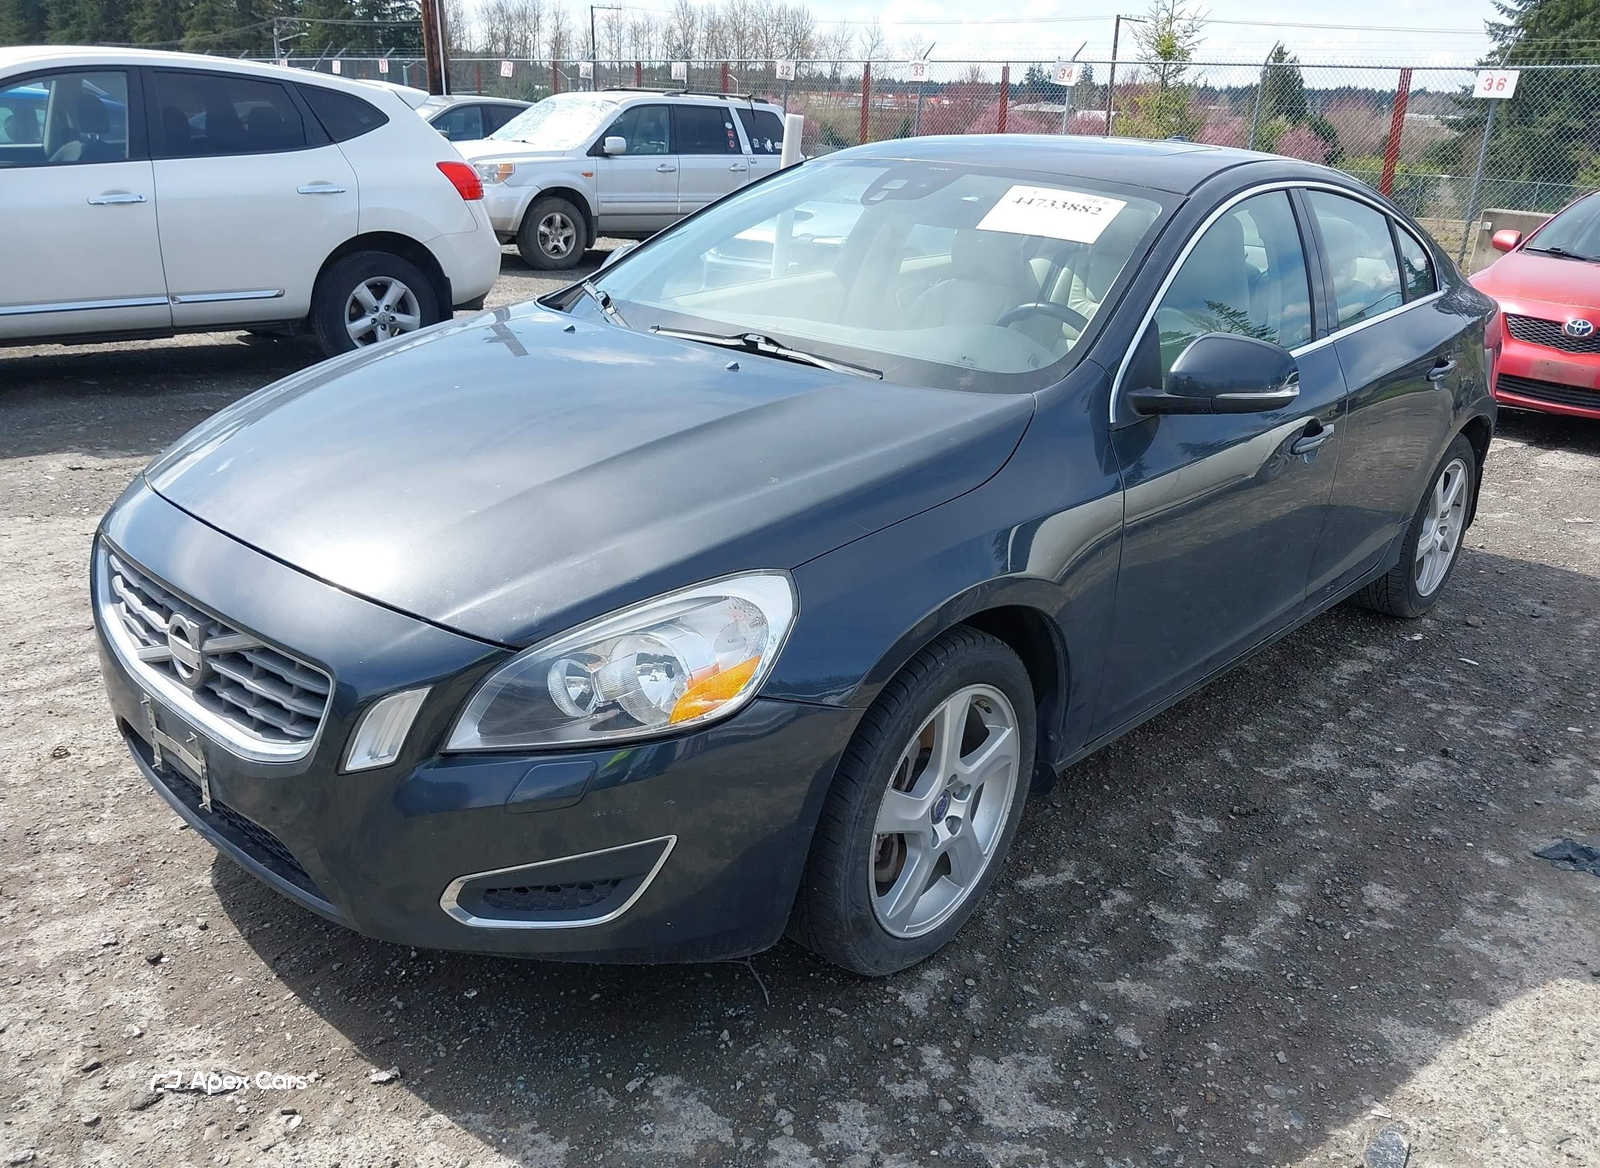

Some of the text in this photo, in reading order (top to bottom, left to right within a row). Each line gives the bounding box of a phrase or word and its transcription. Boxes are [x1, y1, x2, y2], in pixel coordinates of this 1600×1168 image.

[502, 62, 512, 76] 29
[780, 66, 790, 76] 32
[913, 65, 925, 77] 33
[1058, 69, 1073, 80] 34
[1483, 78, 1507, 91] 36
[1012, 196, 1102, 216] 44733882
